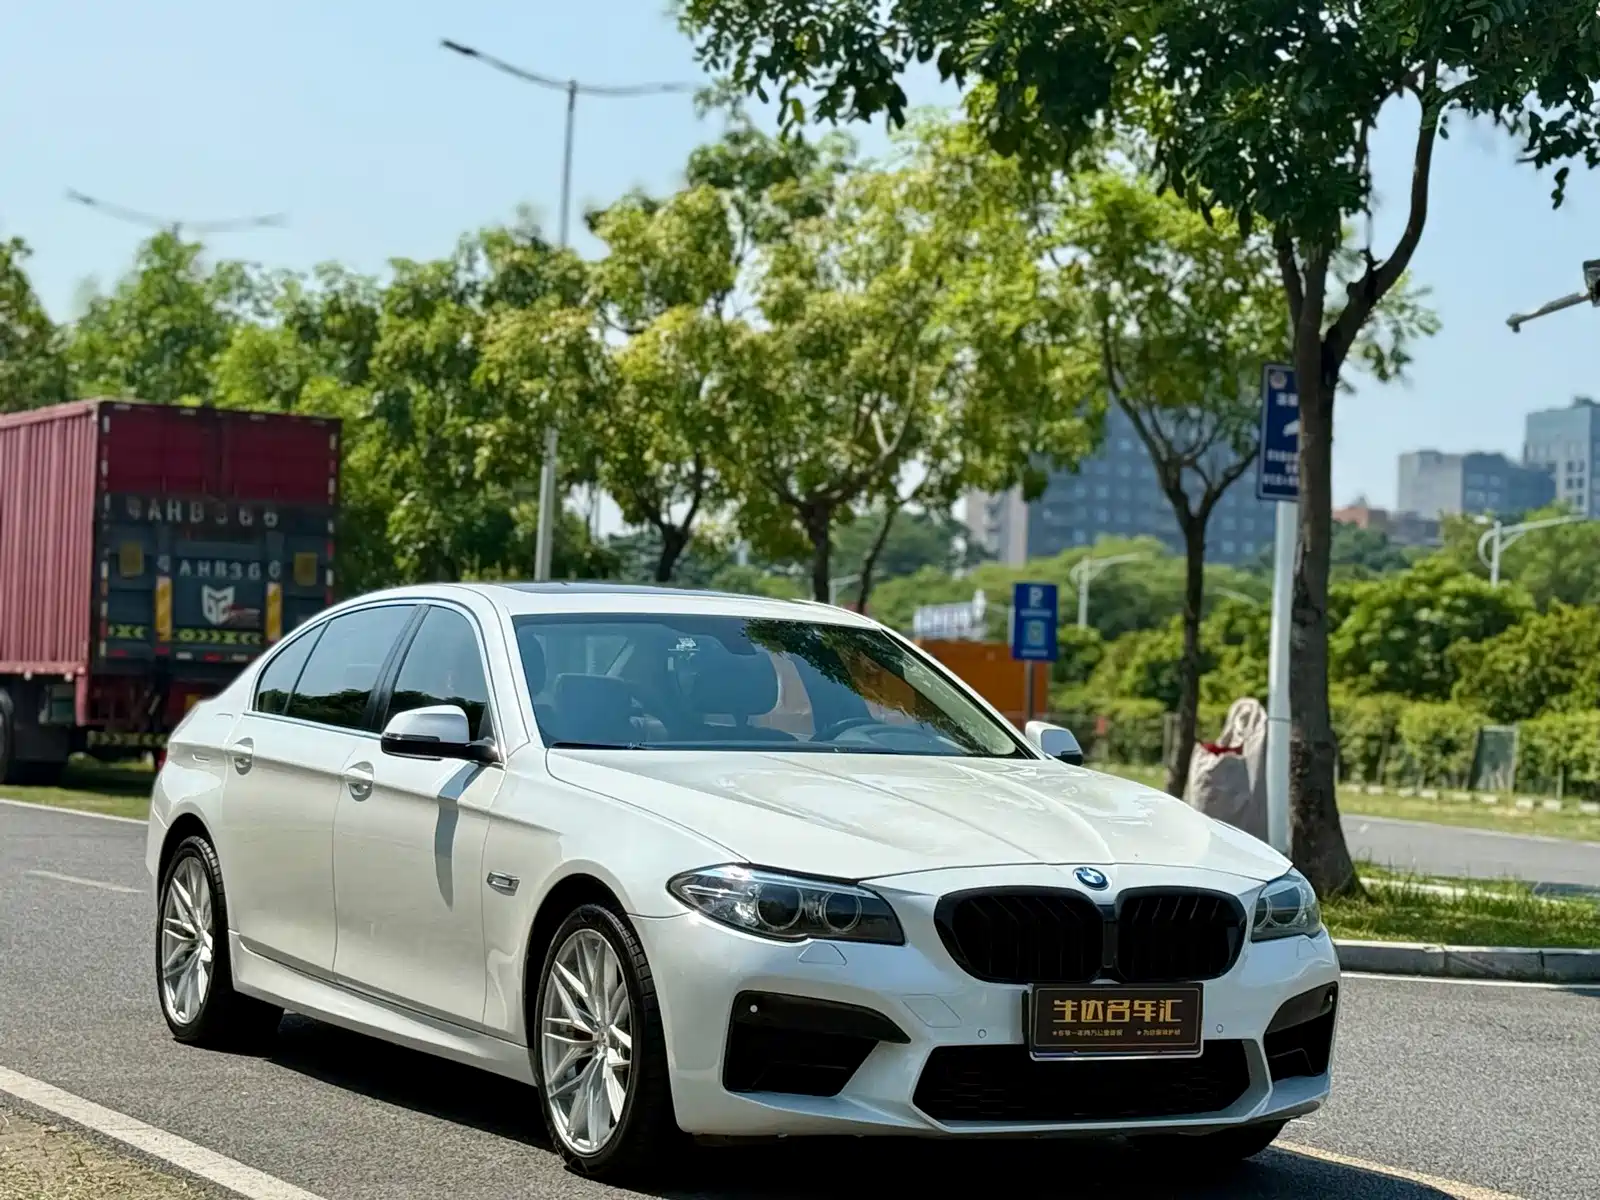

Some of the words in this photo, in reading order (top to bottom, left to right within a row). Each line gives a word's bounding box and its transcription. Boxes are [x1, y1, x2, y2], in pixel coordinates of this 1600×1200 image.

[1029, 586, 1043, 608] P
[1052, 999, 1182, 1023] 生达名车汇
